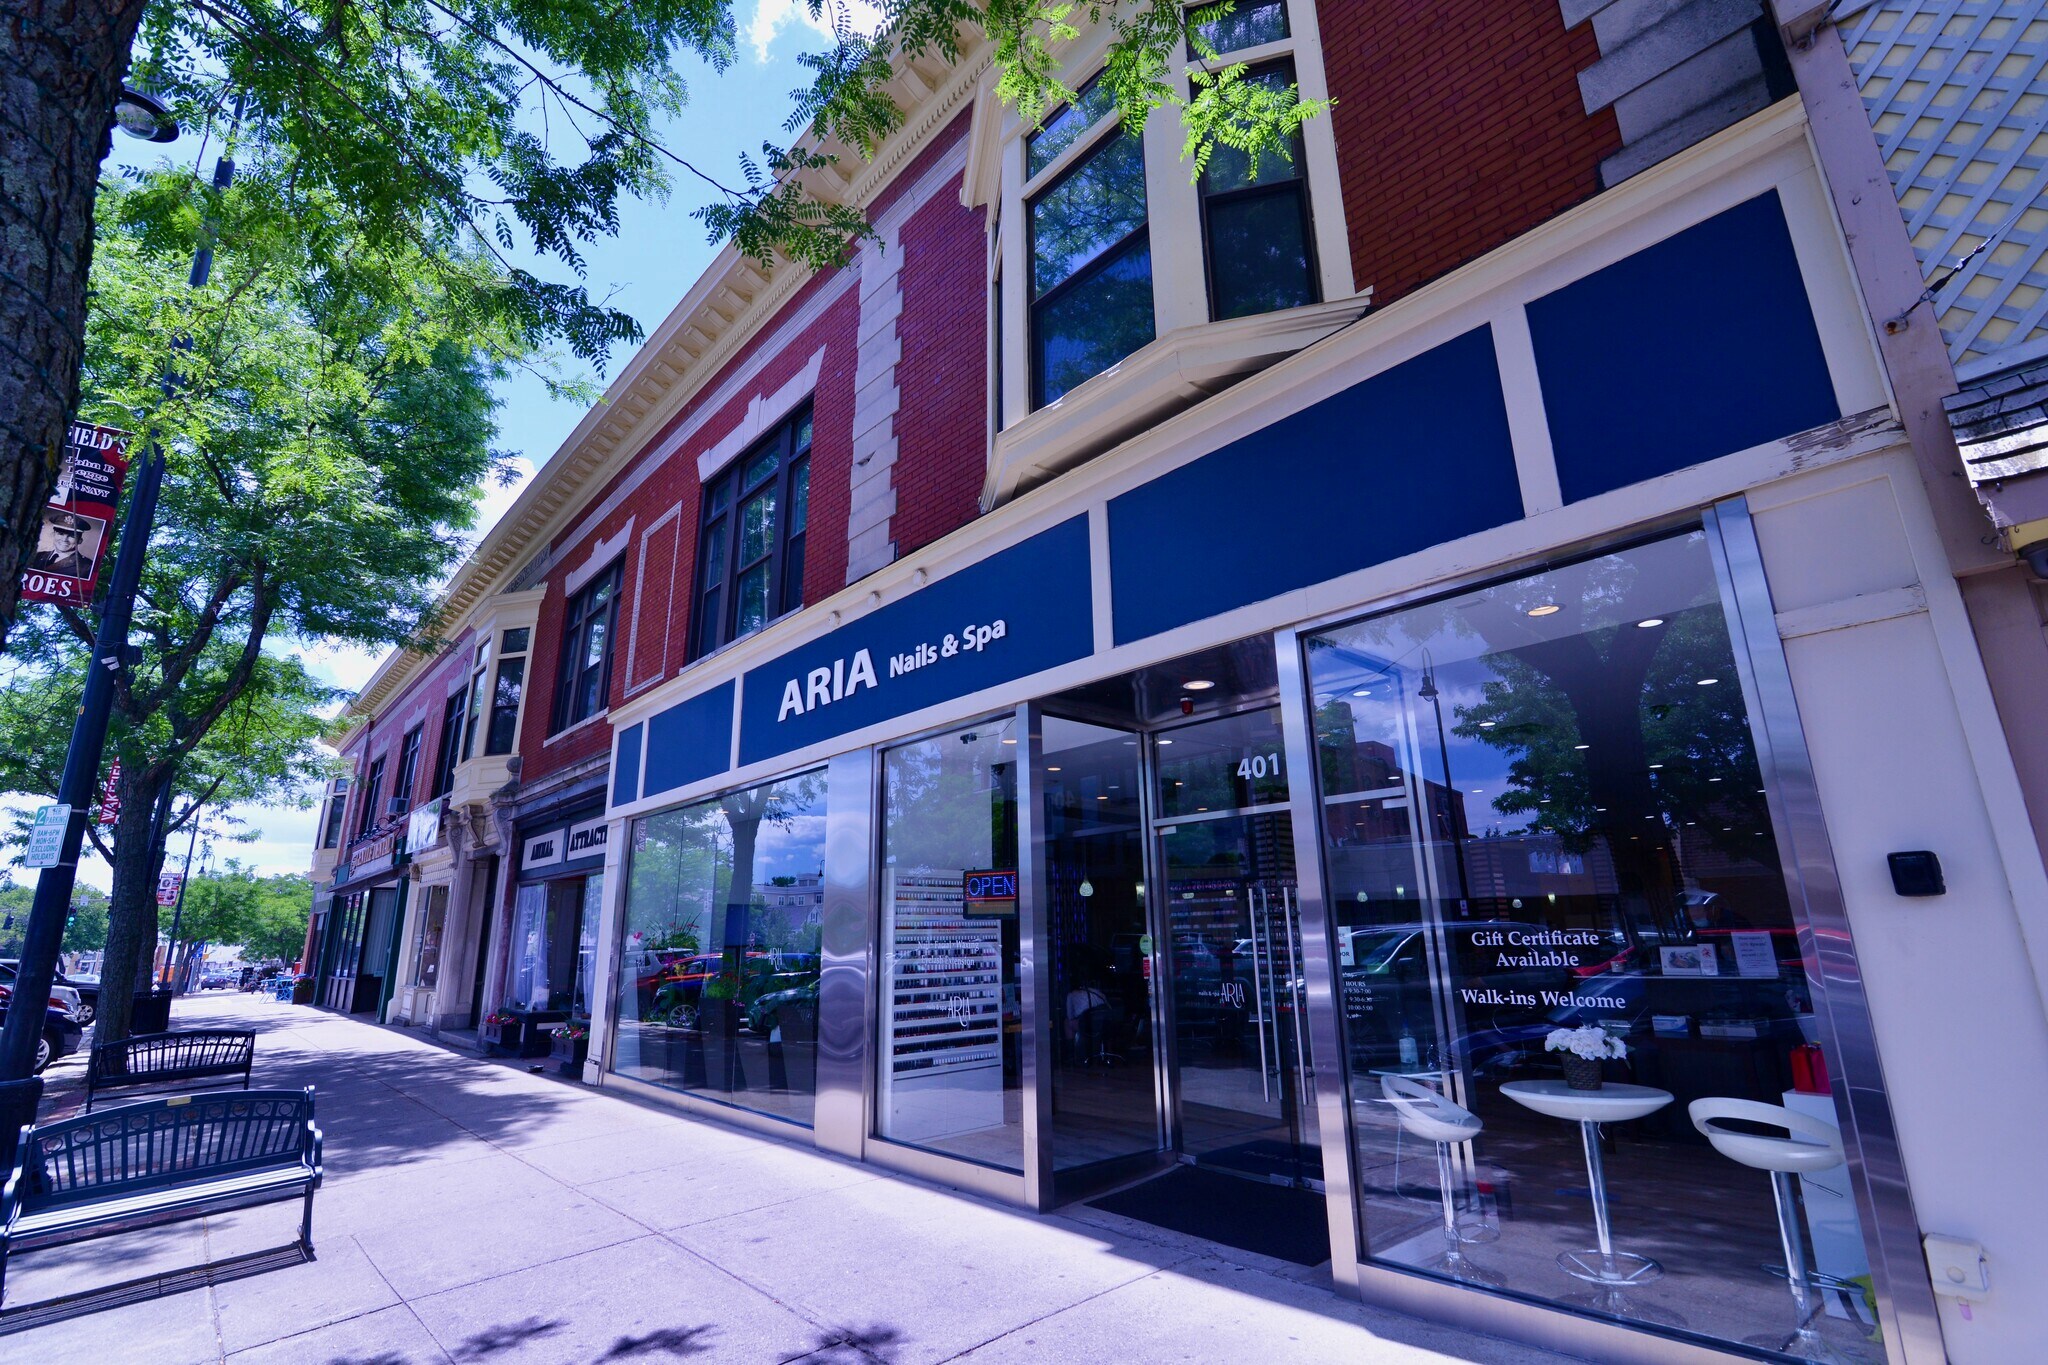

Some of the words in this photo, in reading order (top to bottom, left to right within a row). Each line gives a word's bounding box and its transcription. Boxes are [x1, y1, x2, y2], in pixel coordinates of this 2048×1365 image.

[81, 485, 111, 497] NAVY
[777, 648, 878, 722] ARIA
[890, 643, 938, 678] Nails
[941, 633, 959, 658] &
[962, 619, 1006, 652] Spa
[1237, 752, 1279, 780] 401
[36, 808, 47, 825] 2
[47, 816, 67, 824] PARKING
[31, 845, 58, 853] EXCLUDING
[968, 876, 1015, 896] OPEN
[956, 939, 979, 951] Waxing
[1471, 931, 1504, 946] Gift
[1508, 930, 1599, 946] Certificate
[1496, 952, 1579, 967] Available
[1221, 982, 1245, 1008] ARIA
[1461, 989, 1536, 1006] Walk-ins
[1540, 991, 1626, 1009] Welcome
[948, 996, 970, 1027] ARIA
